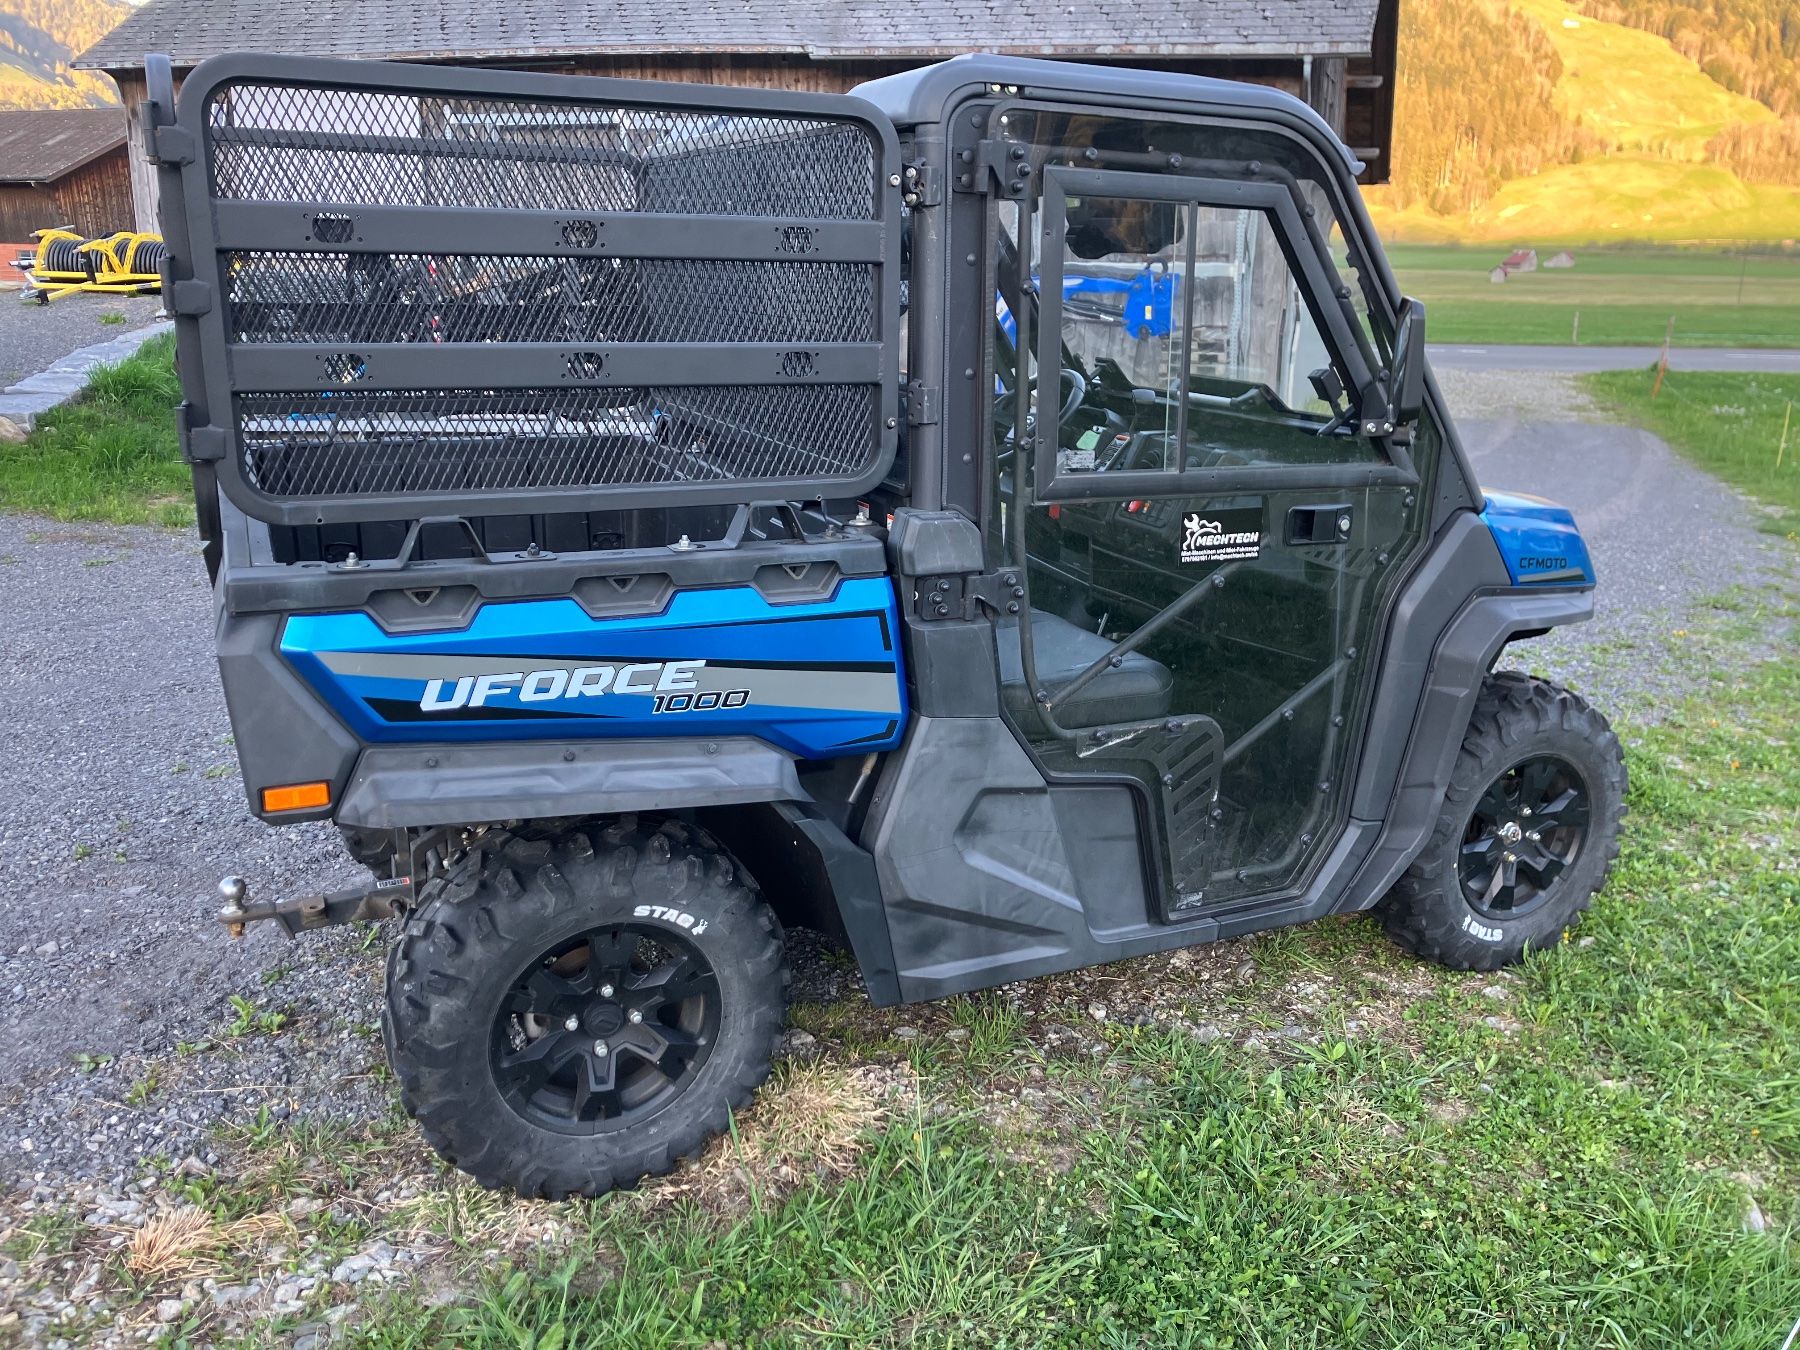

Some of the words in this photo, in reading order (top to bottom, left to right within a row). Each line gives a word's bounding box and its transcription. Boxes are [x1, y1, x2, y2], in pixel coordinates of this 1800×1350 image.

[1195, 532, 1259, 547] MECHTECH
[1217, 547, 1226, 555] und
[1519, 557, 1568, 569] CFMOTO
[419, 659, 707, 712] UFORCE
[652, 688, 752, 715] 1000
